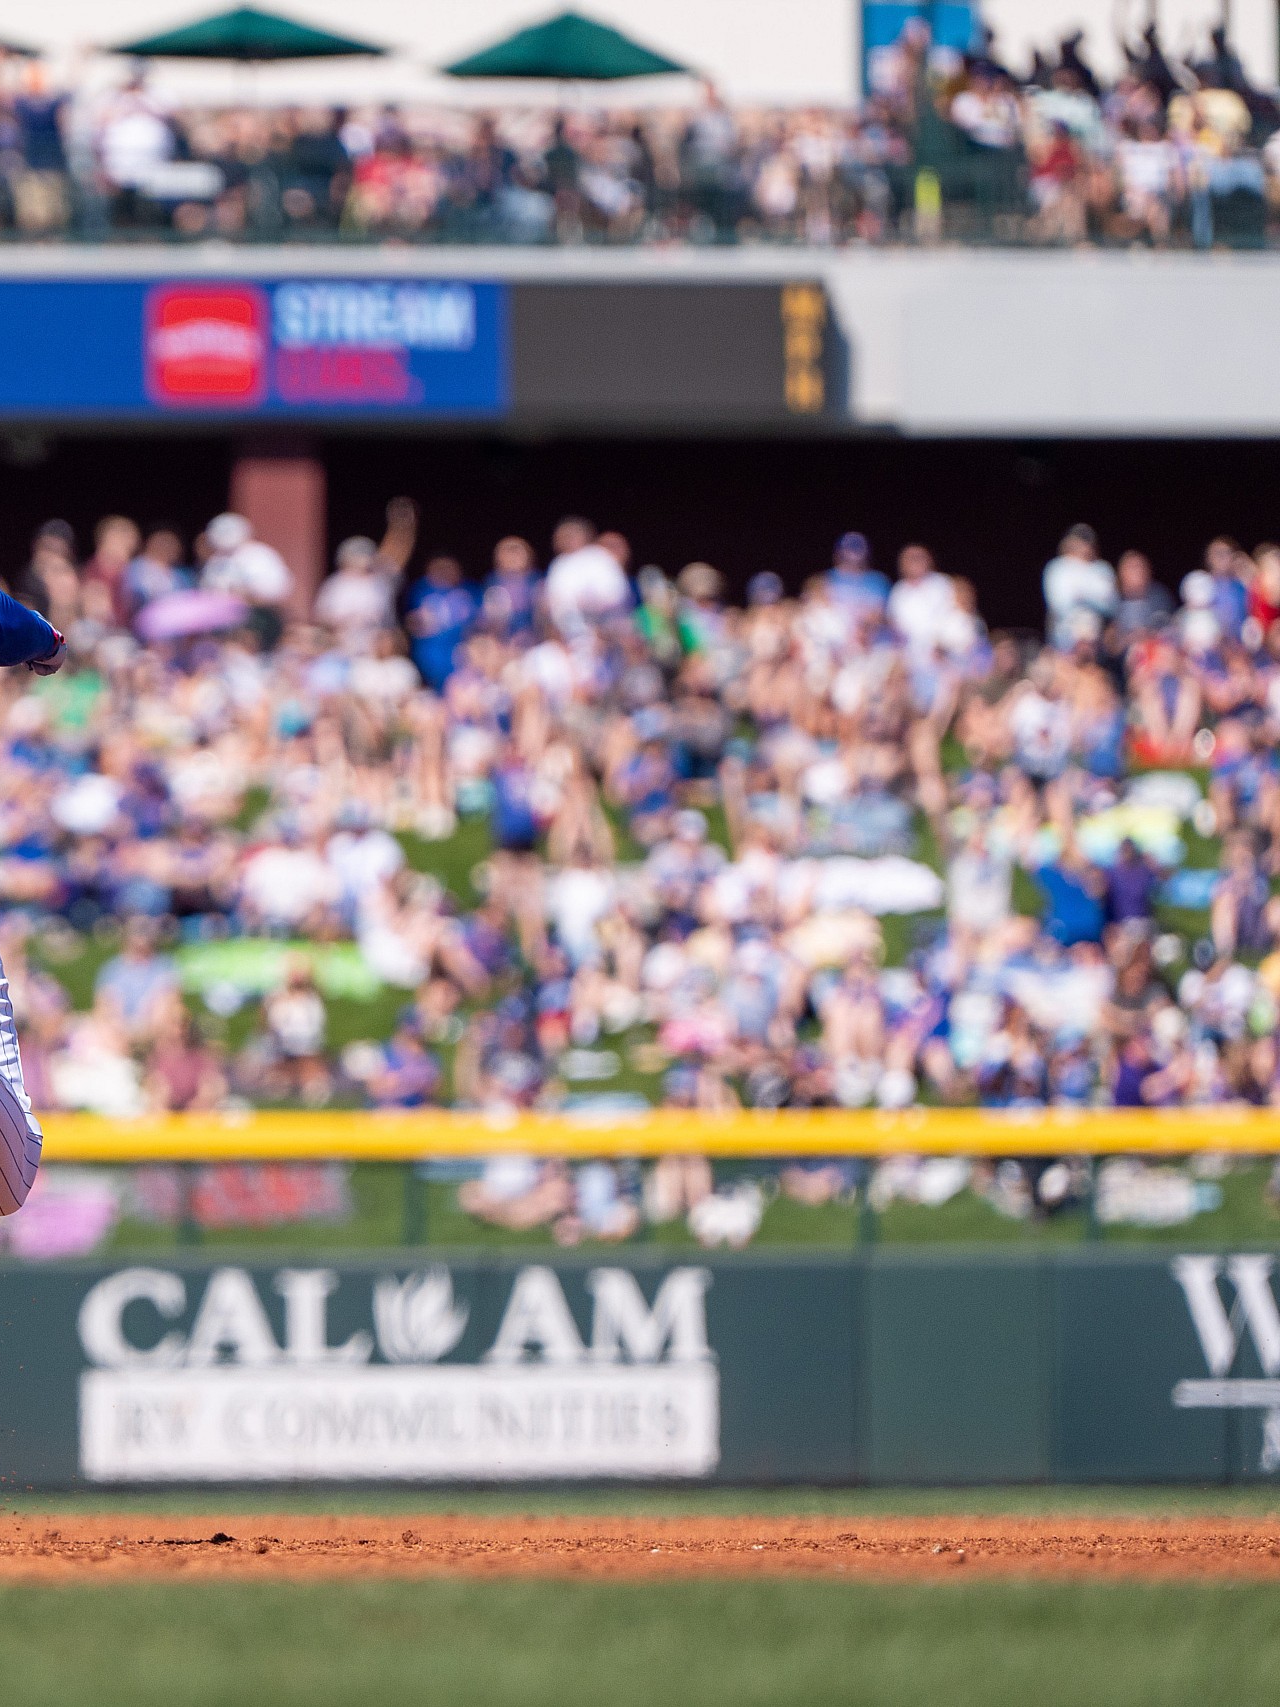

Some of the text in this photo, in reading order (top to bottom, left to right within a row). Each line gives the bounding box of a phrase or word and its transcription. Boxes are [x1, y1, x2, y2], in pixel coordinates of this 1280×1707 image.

[273, 282, 474, 349] STREAM
[77, 1266, 717, 1367] CAL AM
